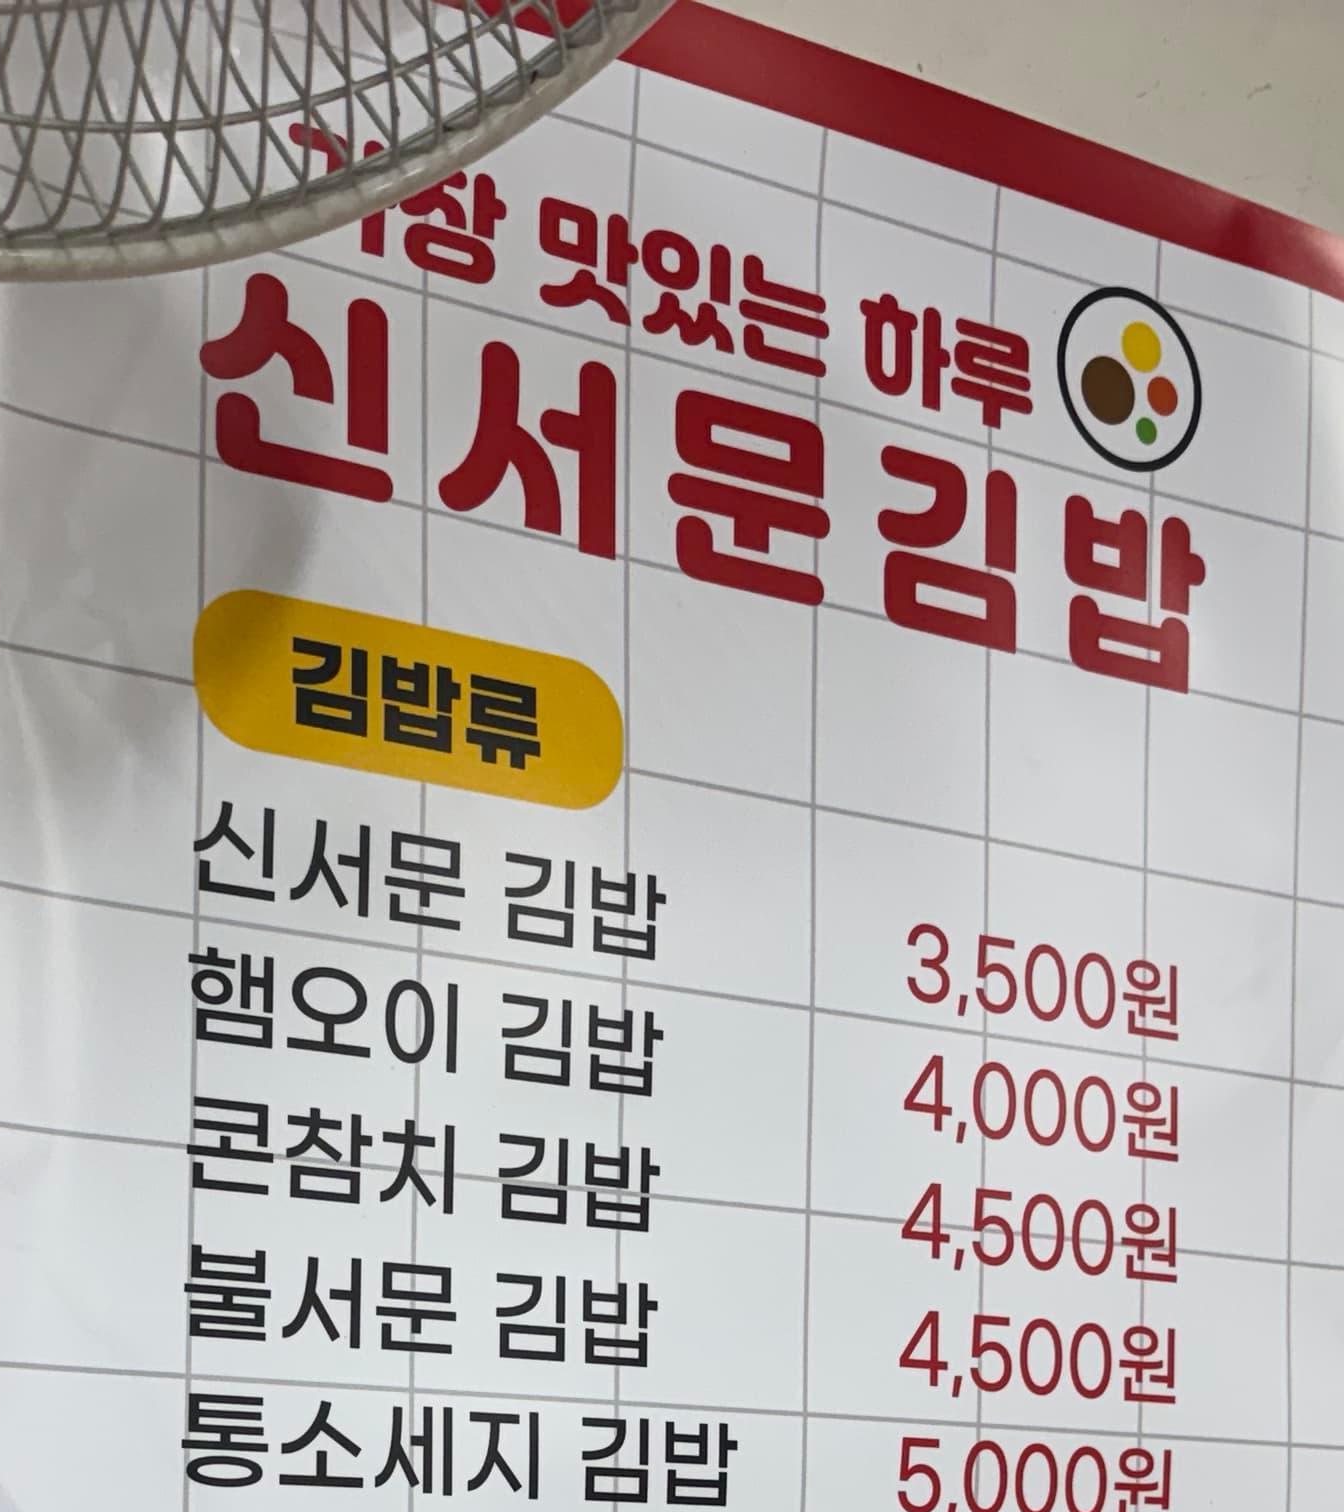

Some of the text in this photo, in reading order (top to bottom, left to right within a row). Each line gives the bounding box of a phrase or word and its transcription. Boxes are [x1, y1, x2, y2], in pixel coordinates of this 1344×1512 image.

[538, 196, 829, 379] 맛있는
[860, 293, 1034, 430] 하루
[291, 636, 542, 770] 김밥류
[193, 800, 1180, 1042] 신서문 김밥 3,500원
[187, 945, 1180, 1163] 햄오이 김밥 4,000원
[186, 1095, 1180, 1285] 콘참치 김밥 4,500원
[183, 1244, 1178, 1407] 불서문 김밥 4,500원
[181, 1392, 543, 1502] 통소세지
[578, 1415, 738, 1509] 김밥
